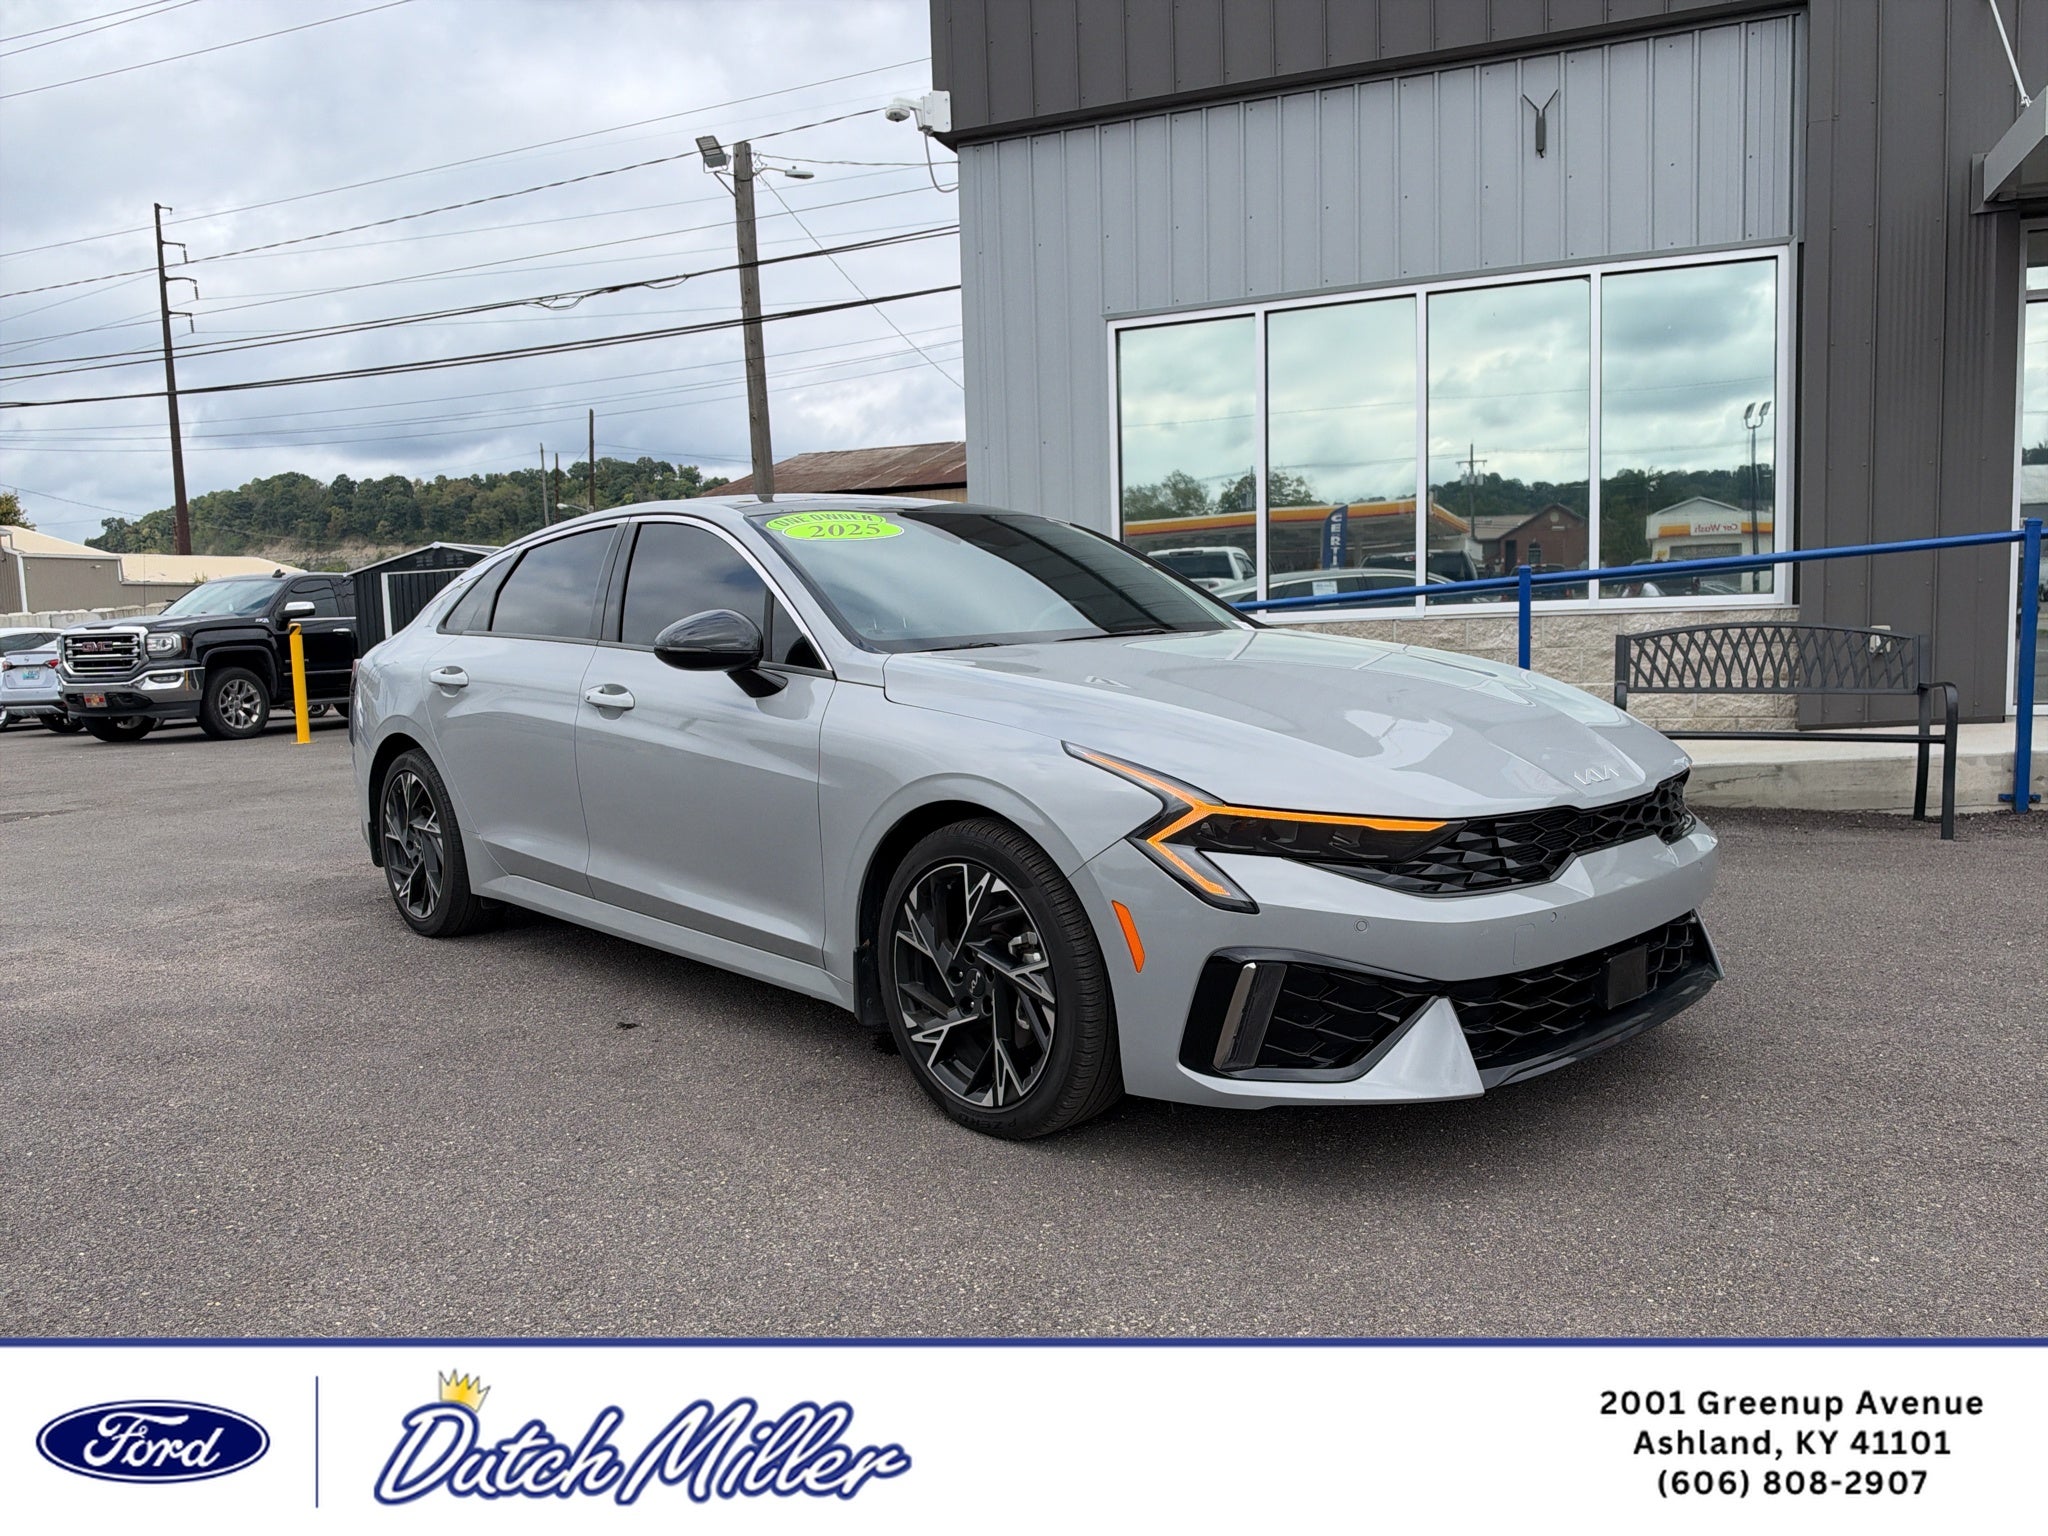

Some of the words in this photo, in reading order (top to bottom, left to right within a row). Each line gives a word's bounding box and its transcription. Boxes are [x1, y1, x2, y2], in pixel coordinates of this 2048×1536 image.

[774, 516, 806, 527] ONE
[810, 513, 873, 522] OWNER
[808, 523, 881, 538] 2025
[1330, 513, 1342, 571] CERTI
[82, 641, 113, 653] GMC
